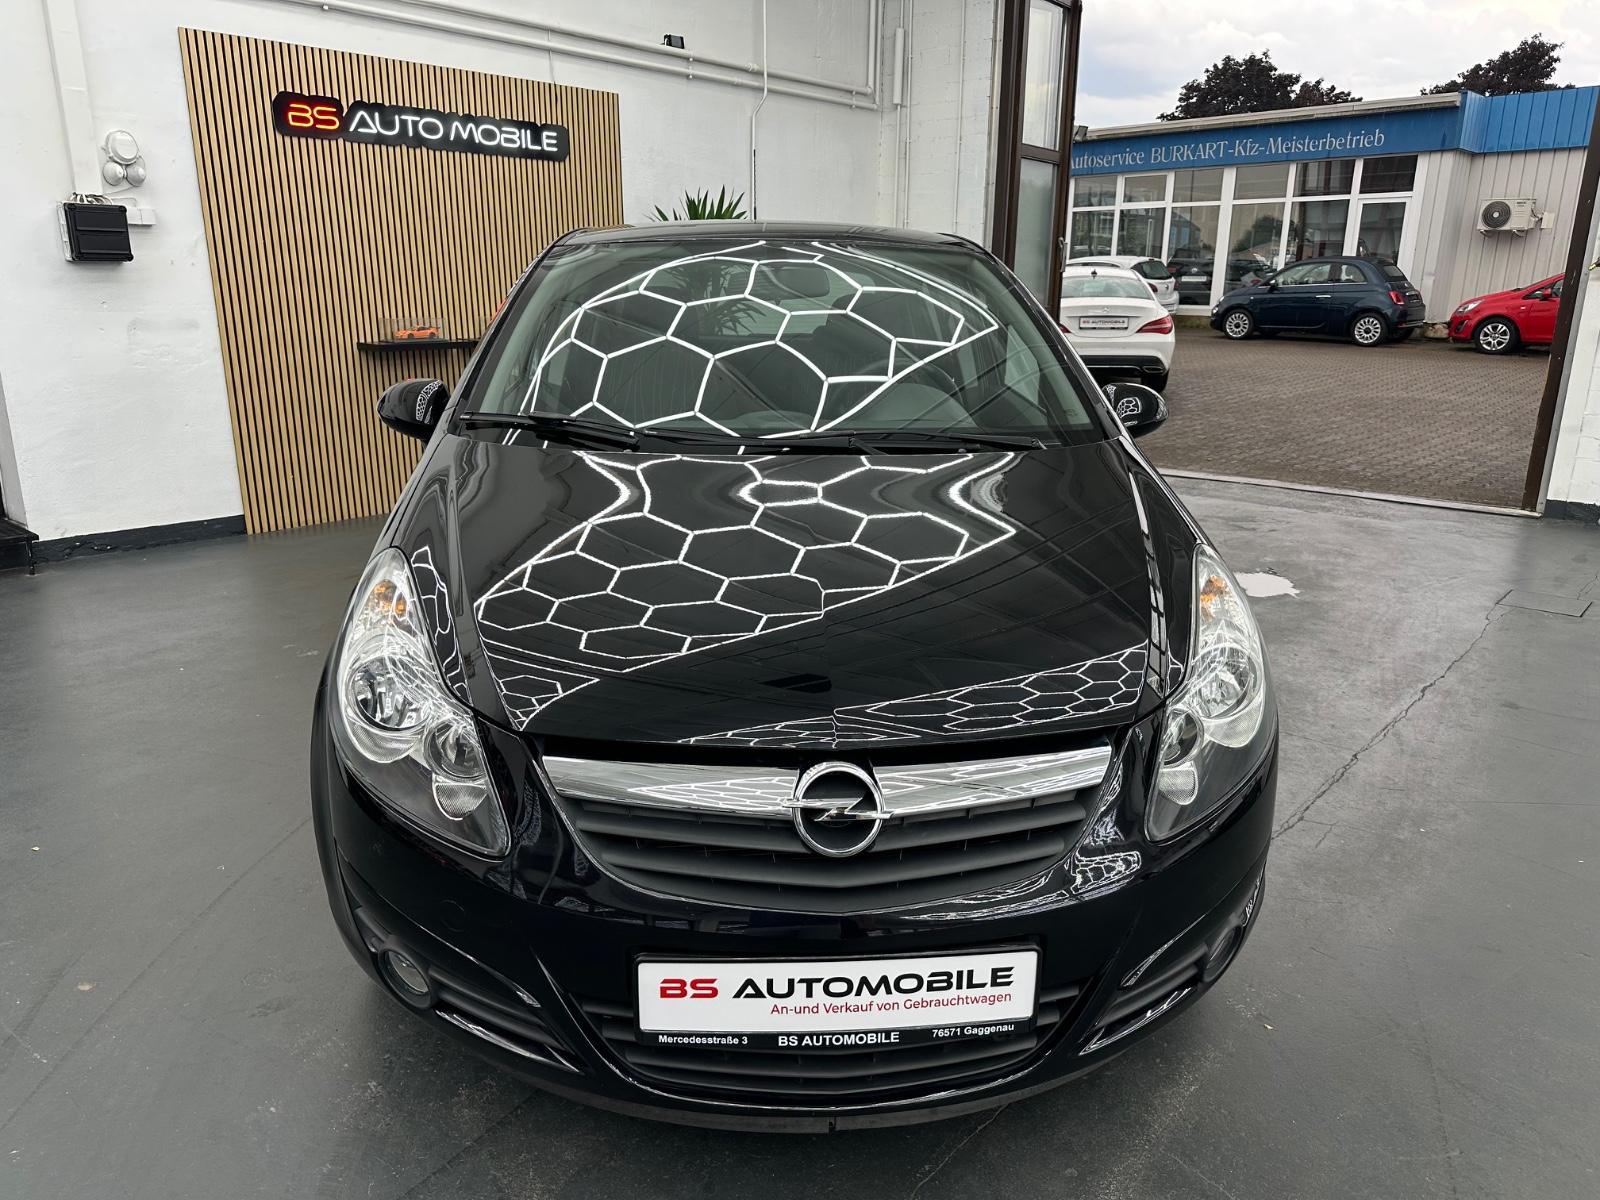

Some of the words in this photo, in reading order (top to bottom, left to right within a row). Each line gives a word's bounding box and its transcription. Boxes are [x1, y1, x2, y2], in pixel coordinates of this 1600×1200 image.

[287, 103, 340, 130] BS
[659, 978, 719, 999] BS
[732, 966, 1015, 999] AUTOMOBILE
[770, 1002, 820, 1015] An-und
[823, 1000, 873, 1014] Verkauf
[876, 1001, 900, 1012] von
[903, 992, 1012, 1010] Gebrauchtwagen
[658, 1034, 739, 1045] Mercedesstraße
[741, 1036, 748, 1045] 3
[778, 1035, 799, 1047] BS
[801, 1031, 900, 1046] AUTOMOBILE
[931, 1027, 962, 1038] 76571
[963, 1023, 1015, 1036] Gaggenau
